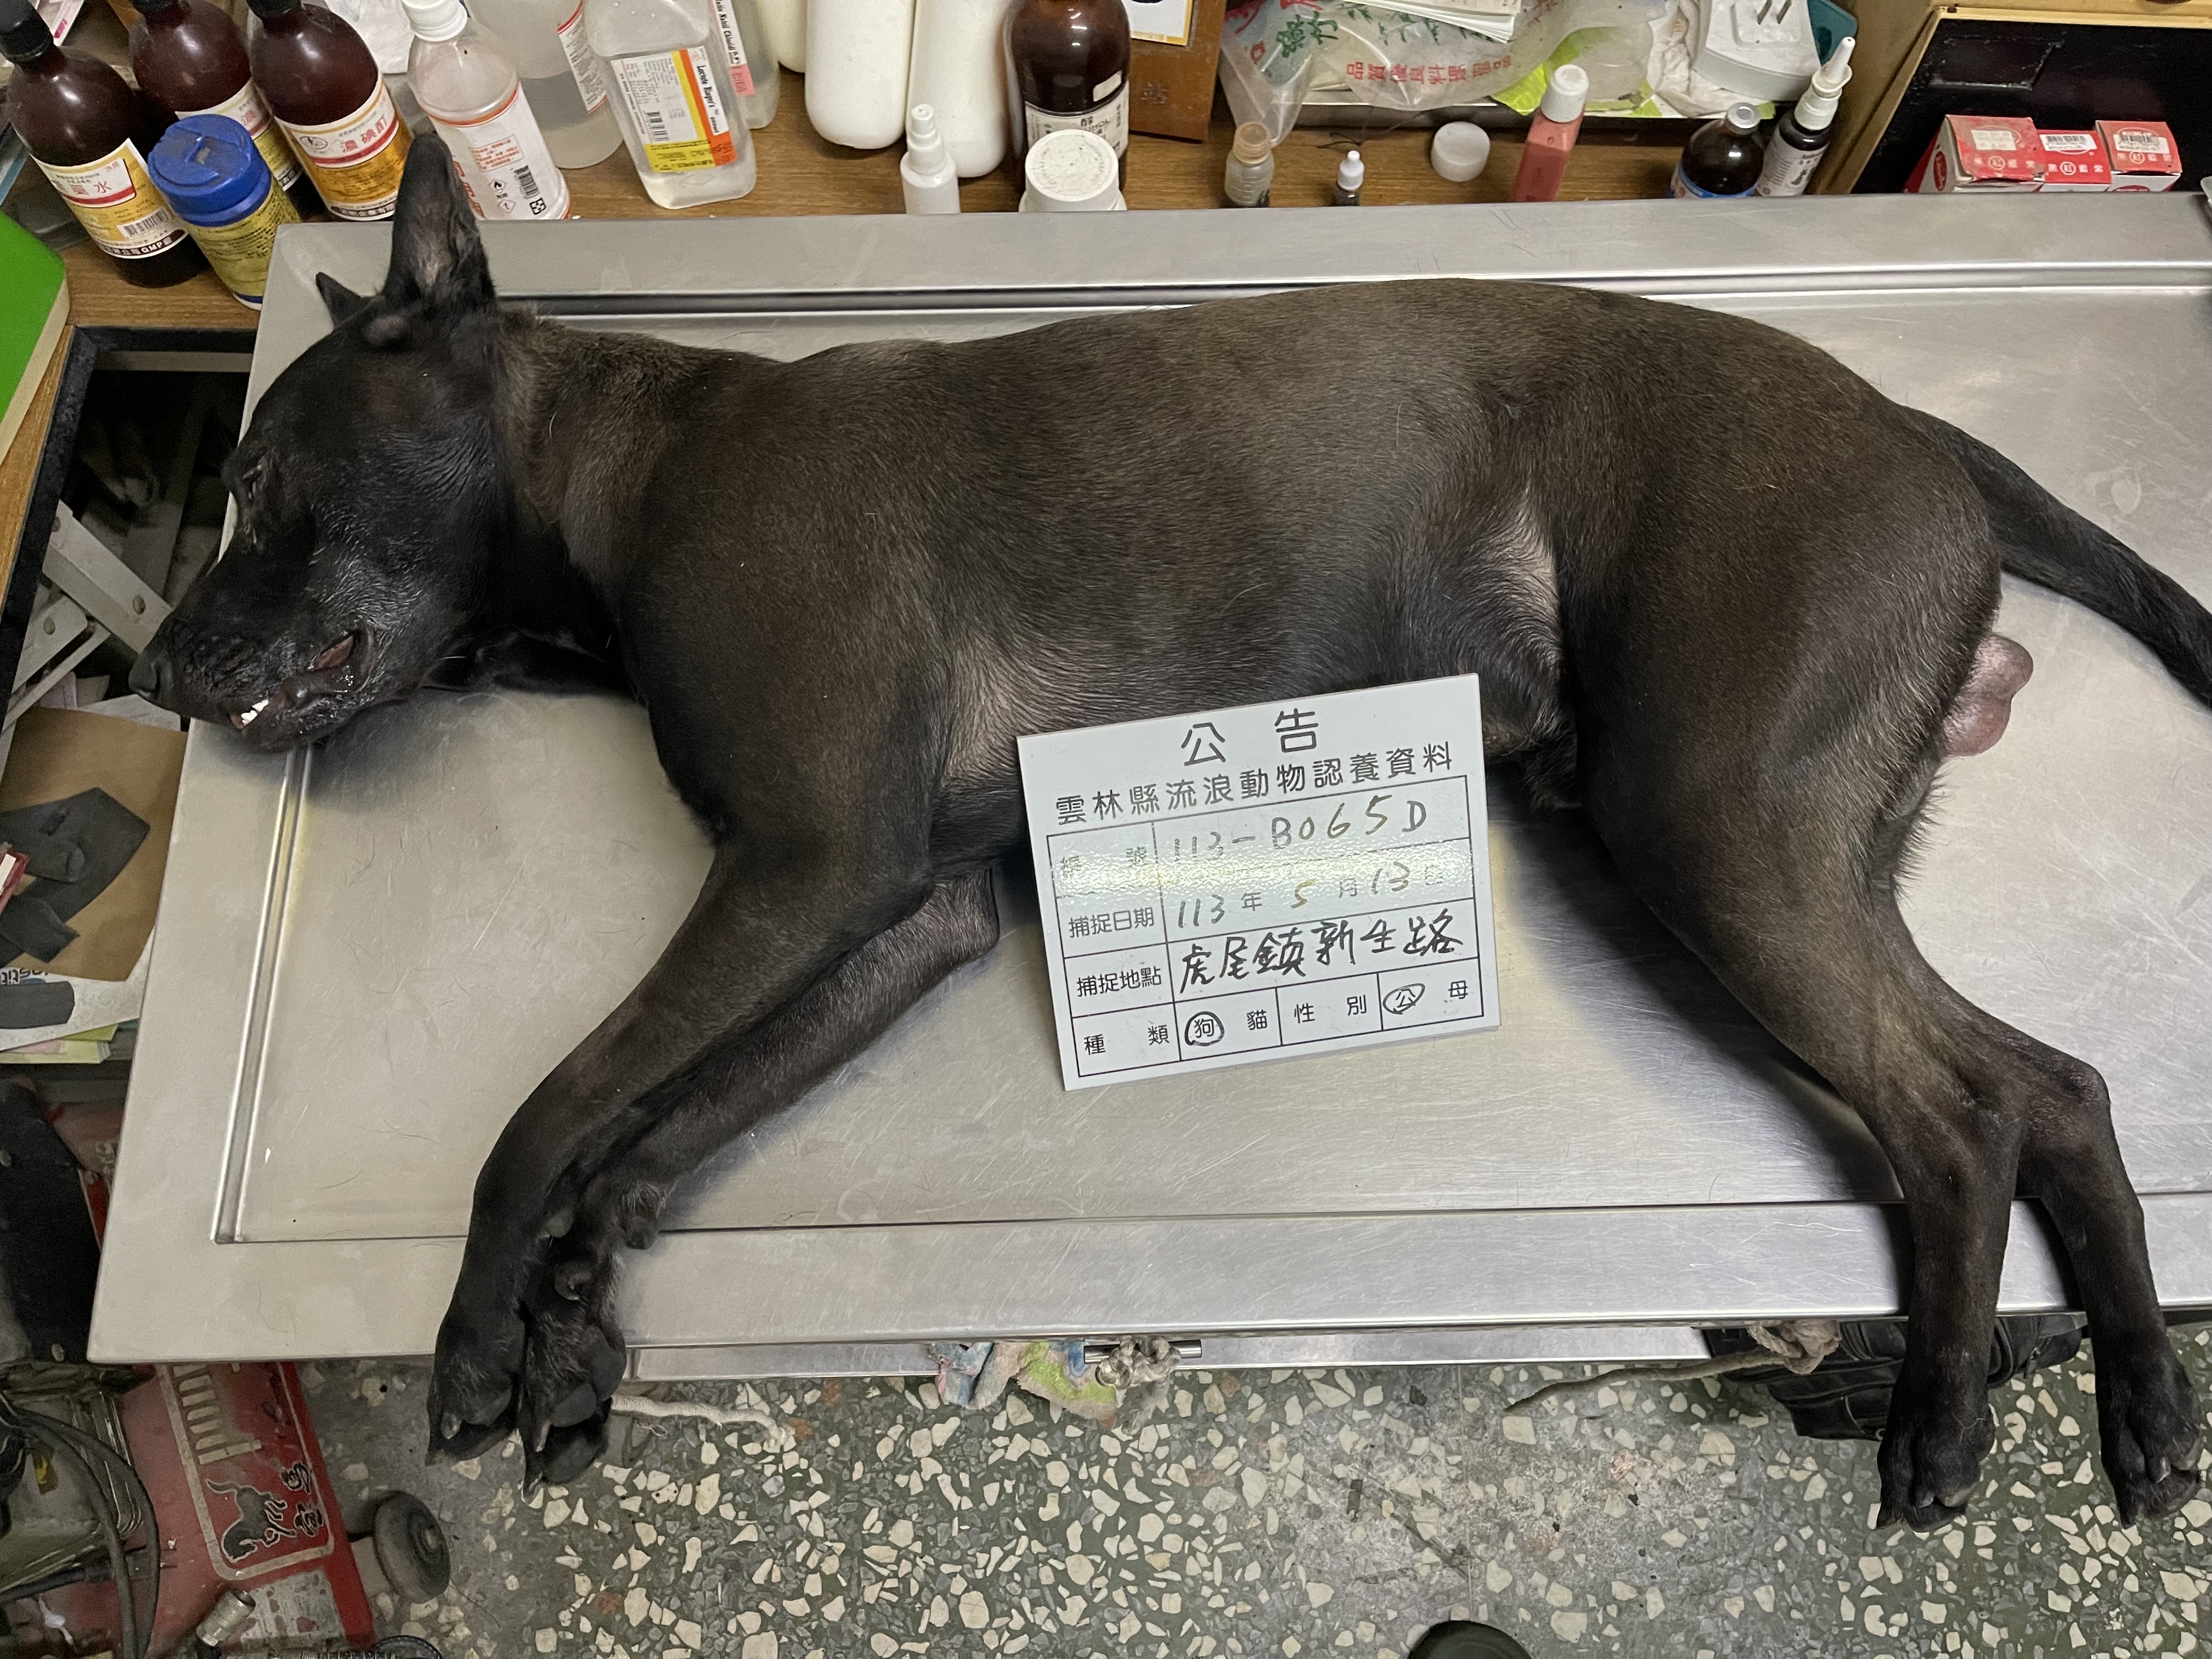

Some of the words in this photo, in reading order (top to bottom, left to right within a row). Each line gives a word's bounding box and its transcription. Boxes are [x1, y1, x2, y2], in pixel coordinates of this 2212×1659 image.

[1056, 741, 1452, 825] 雲林縣流浪動物認養資料
[1069, 907, 1155, 938] 捕捉日期
[1180, 908, 1463, 994] 虎尾鎮新生路
[1076, 966, 1163, 997] 捕捉地點
